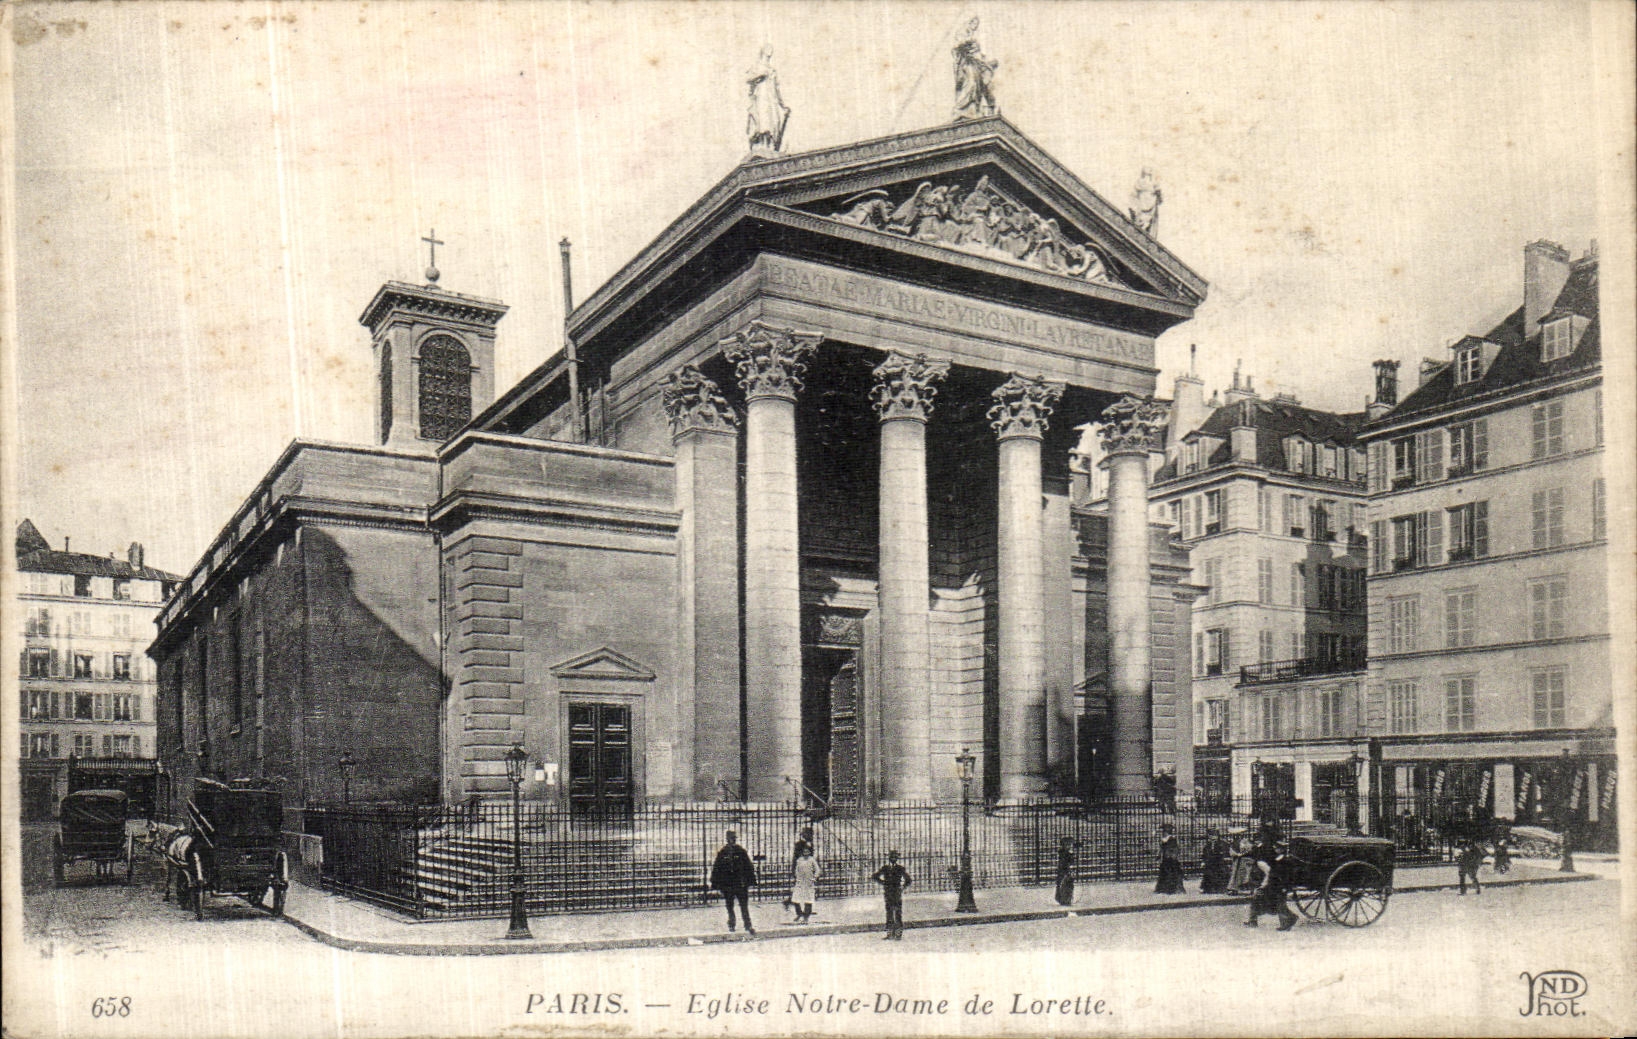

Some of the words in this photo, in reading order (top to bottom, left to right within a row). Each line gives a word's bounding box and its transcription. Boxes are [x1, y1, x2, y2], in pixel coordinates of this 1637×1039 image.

[864, 284, 947, 321] MARIAE
[952, 304, 1028, 338] VIRGINI
[1517, 771, 1532, 810] PIANOS
